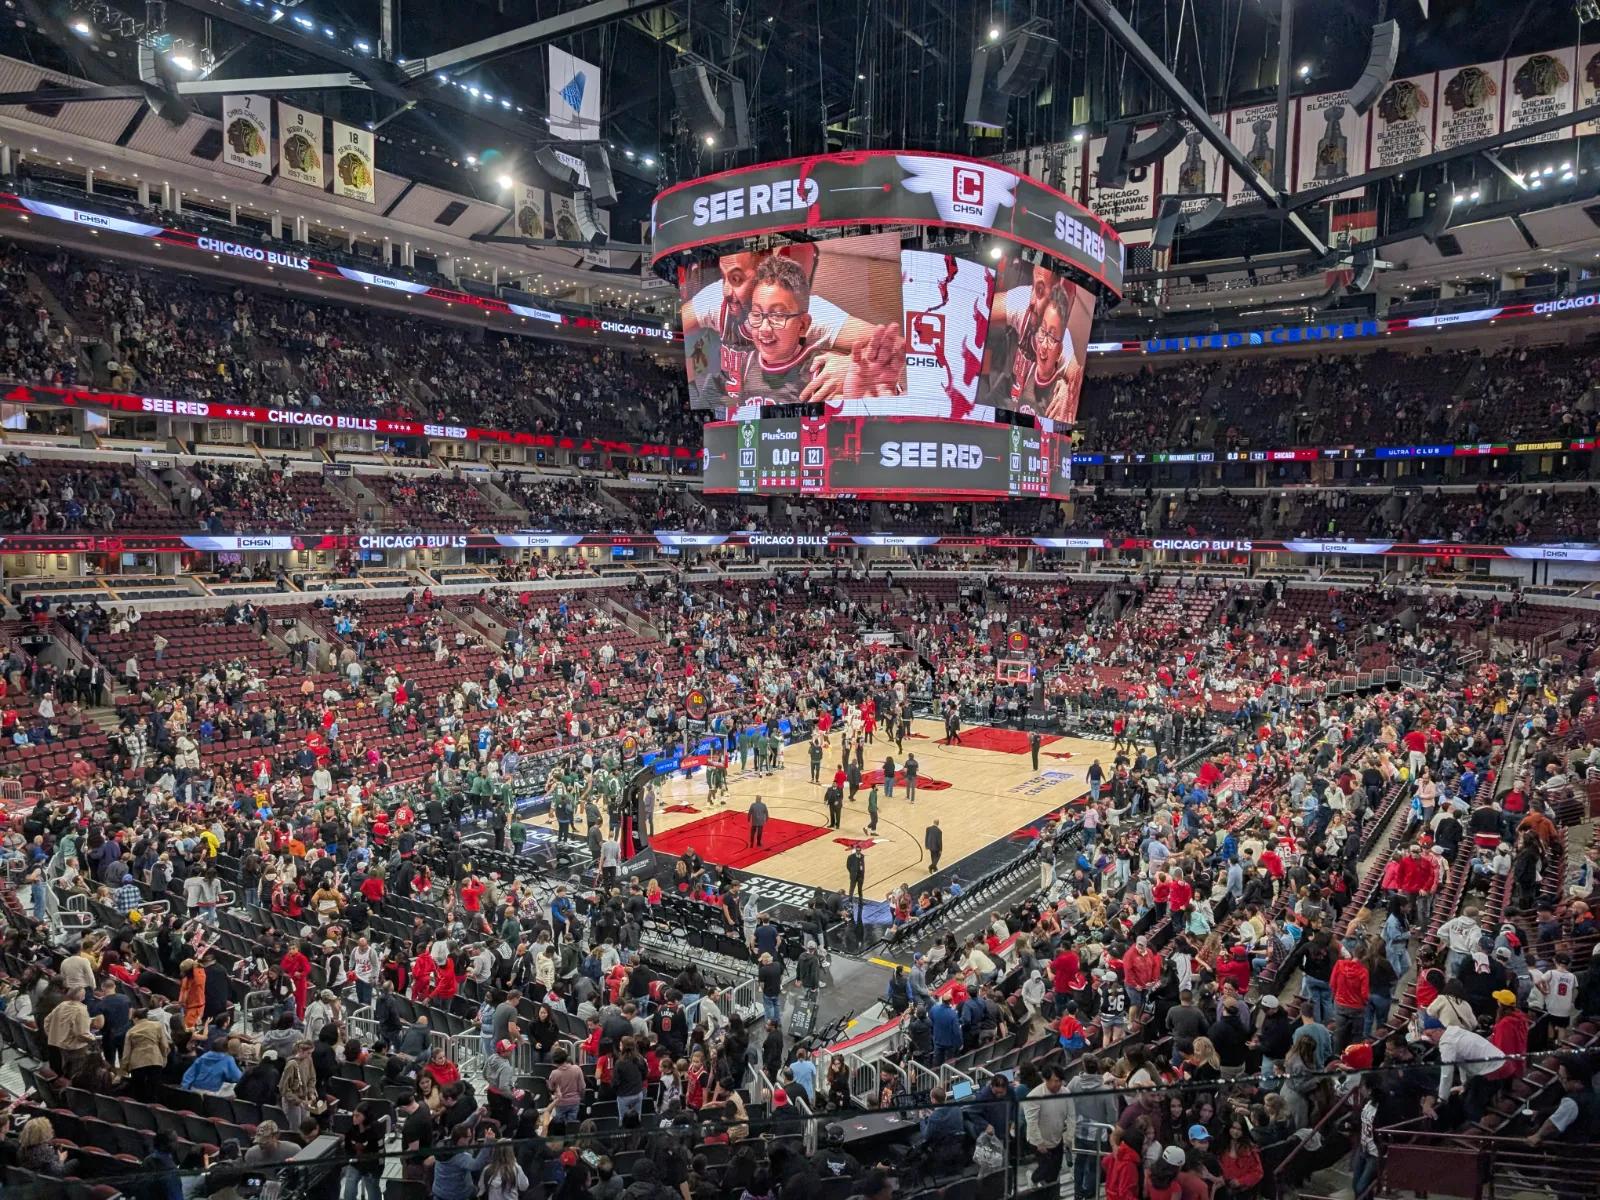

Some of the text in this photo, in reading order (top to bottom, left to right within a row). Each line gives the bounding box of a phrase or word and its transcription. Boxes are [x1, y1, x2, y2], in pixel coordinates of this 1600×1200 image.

[244, 96, 251, 108] 7
[1317, 92, 1348, 103] CHICAG
[1522, 97, 1555, 109] CHICAGO
[1452, 108, 1484, 119] CHICAGO
[1512, 103, 1566, 117] BLACKHAWKS
[297, 114, 304, 125] 9
[1442, 114, 1493, 128] BLACKHAWKS
[1519, 112, 1558, 123] WESTERN
[1386, 120, 1418, 131] CHICAGO
[1448, 122, 1486, 133] WESTERN
[350, 131, 359, 144] 18
[1378, 126, 1425, 140] BLACKHAWKS
[1383, 134, 1420, 145] WESTERN
[1442, 128, 1492, 141] CONFERENCE
[1377, 140, 1425, 153] CONFERENCE
[1380, 147, 1421, 159] CHAMPIONS
[1099, 189, 1139, 200] CHICAGO
[693, 177, 819, 227] SEE RED
[1092, 196, 1149, 210] BLACKHAWKS
[953, 204, 983, 216] CHSN
[1094, 204, 1146, 216] CENTENNIAL
[80, 214, 108, 226] CHSN
[1054, 210, 1105, 263] SEE RED
[197, 237, 309, 271] CHICAGO BULLS
[1533, 296, 1594, 313] CHICAGO
[601, 321, 644, 335] CHICAGO
[1147, 320, 1378, 352] UNITED CENTER
[142, 398, 209, 416] SEE RED
[268, 410, 377, 430] CHICAGO BULLS
[424, 424, 467, 439] SEE RED
[762, 431, 797, 441] Plus500
[742, 451, 753, 464] 127
[772, 448, 790, 465] 0.0
[808, 449, 819, 464] 121
[880, 442, 983, 469] SEE RED
[359, 536, 423, 548] CHICAGO
[749, 536, 828, 545] CHICAGO BULLS
[1153, 540, 1210, 550] CHICAGO
